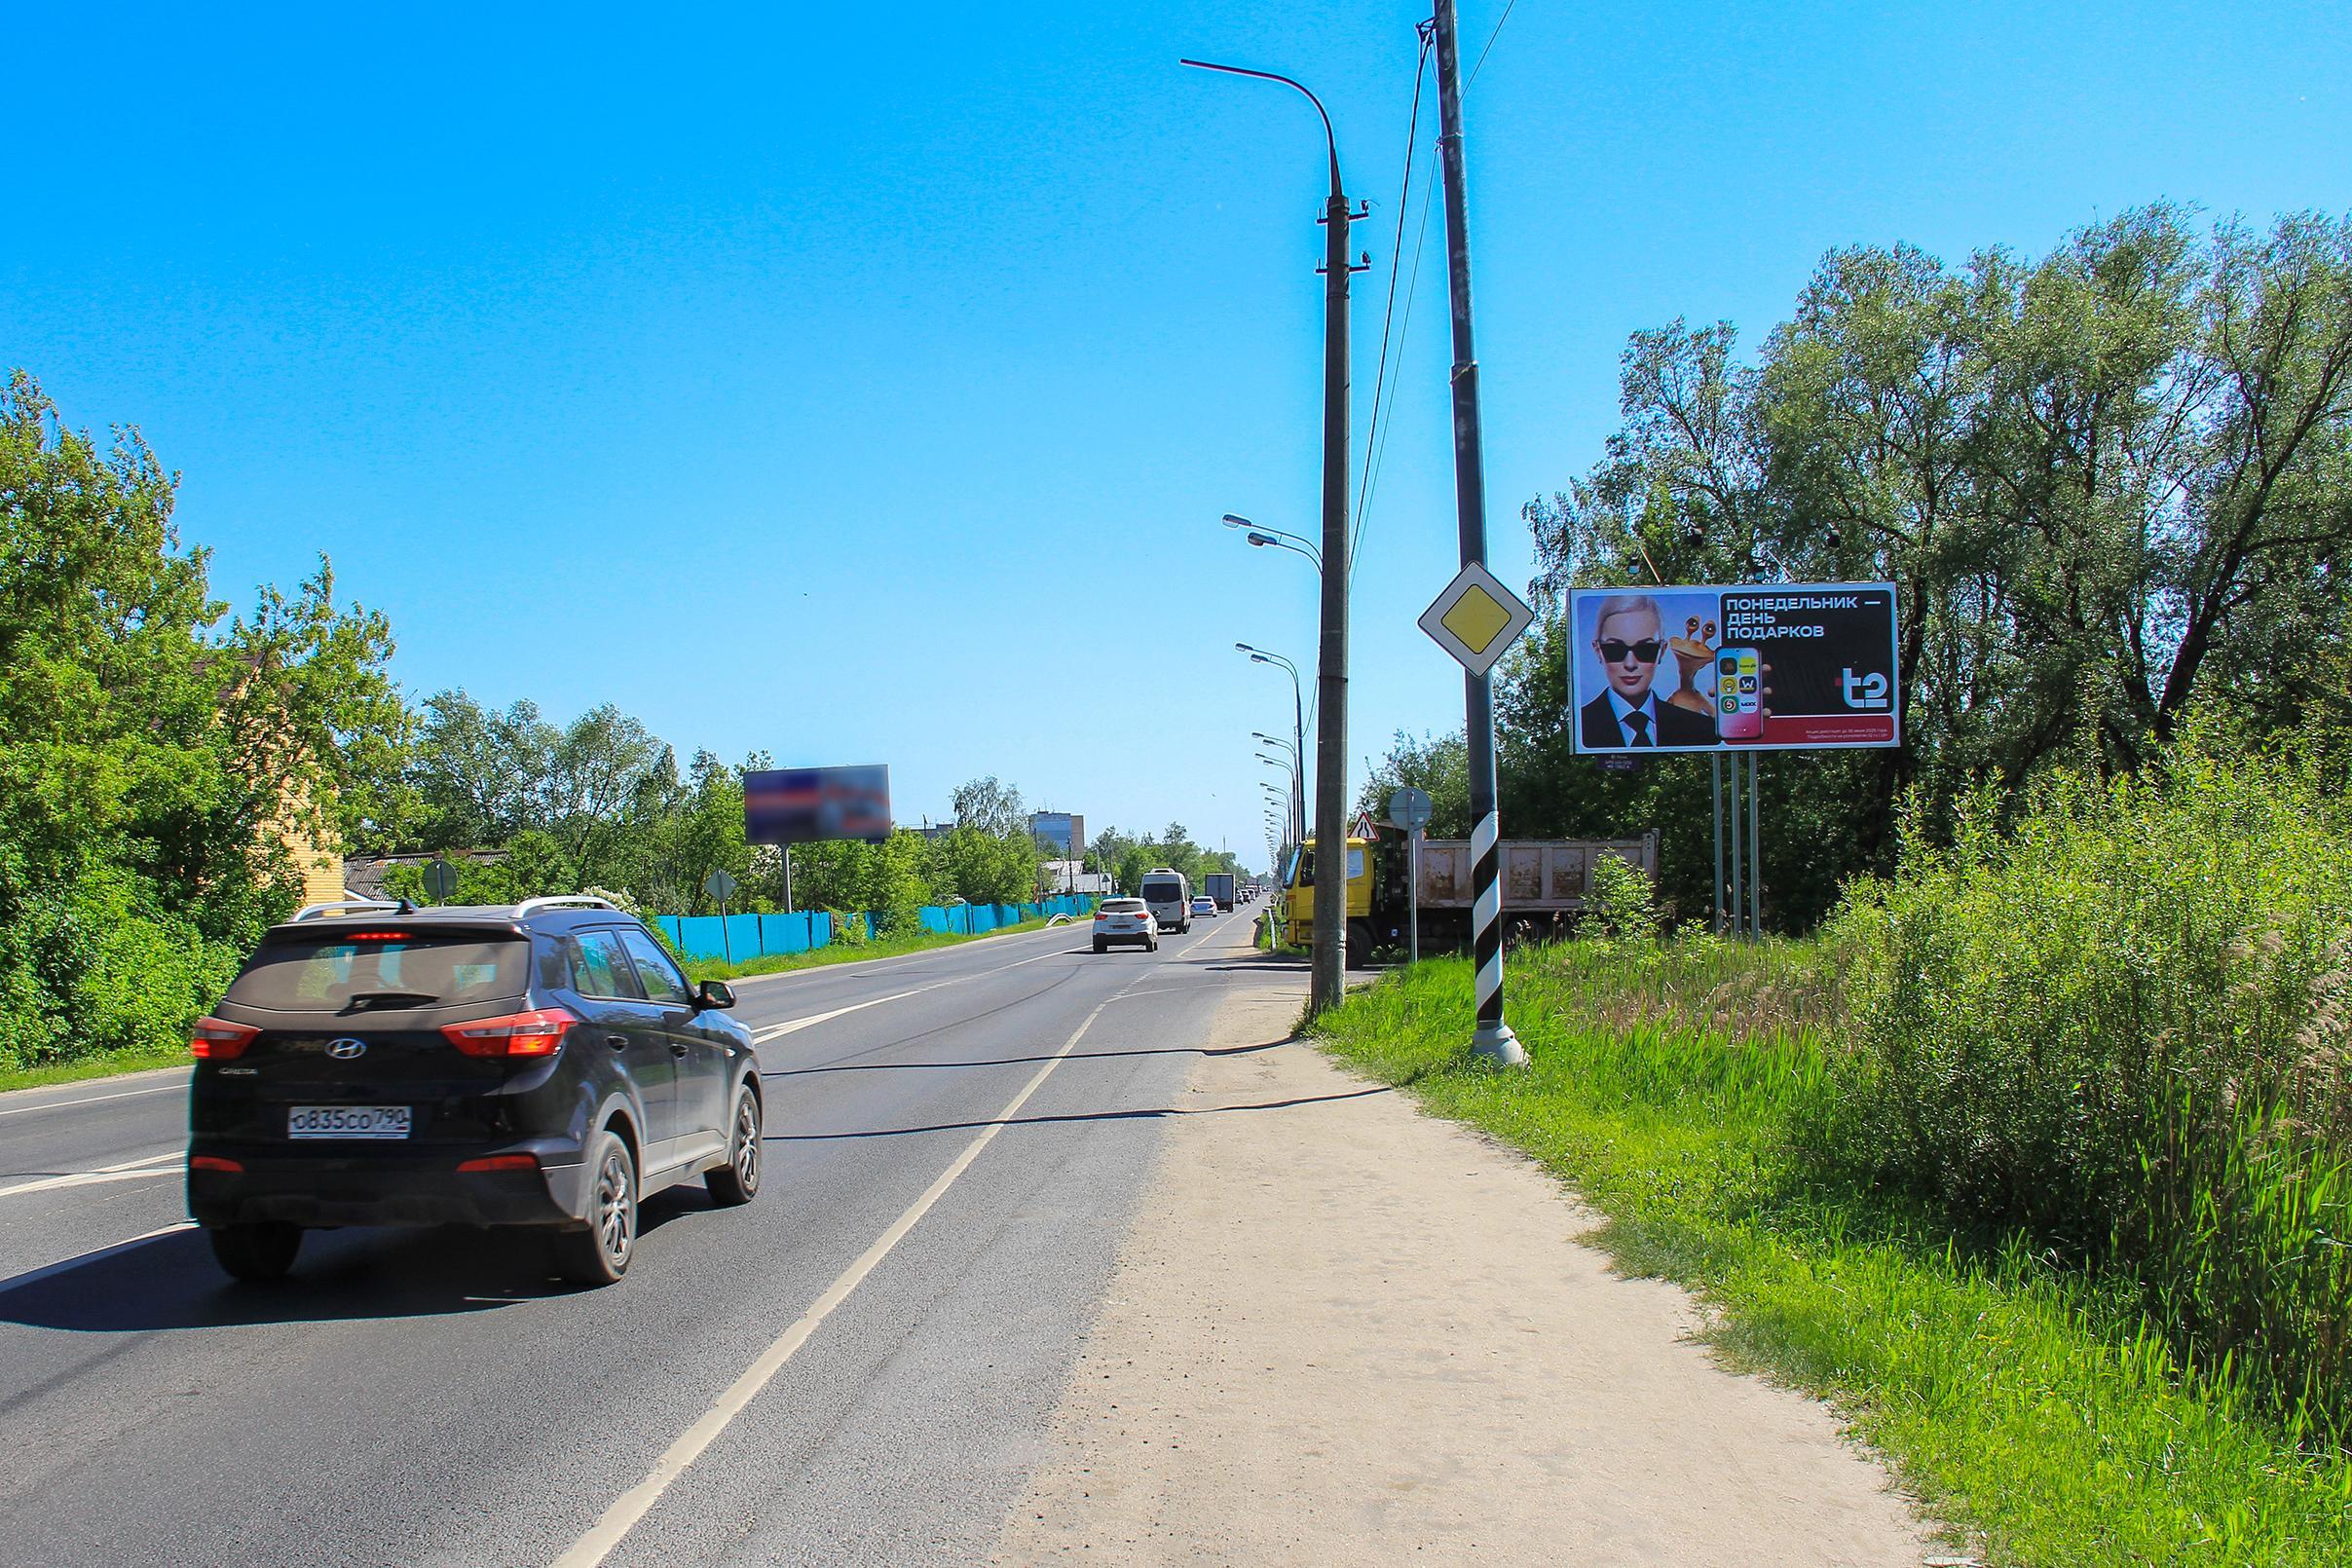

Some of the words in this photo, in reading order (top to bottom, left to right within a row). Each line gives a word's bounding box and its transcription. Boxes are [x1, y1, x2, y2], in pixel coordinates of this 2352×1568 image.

[1727, 596, 1858, 612] ПОНЕДЕЛЬНИК
[1727, 613, 1775, 626] ДЕНЬ
[1727, 625, 1824, 640] ПОДАРКОВ
[1843, 668, 1887, 709] t2
[375, 1108, 406, 1124] 790
